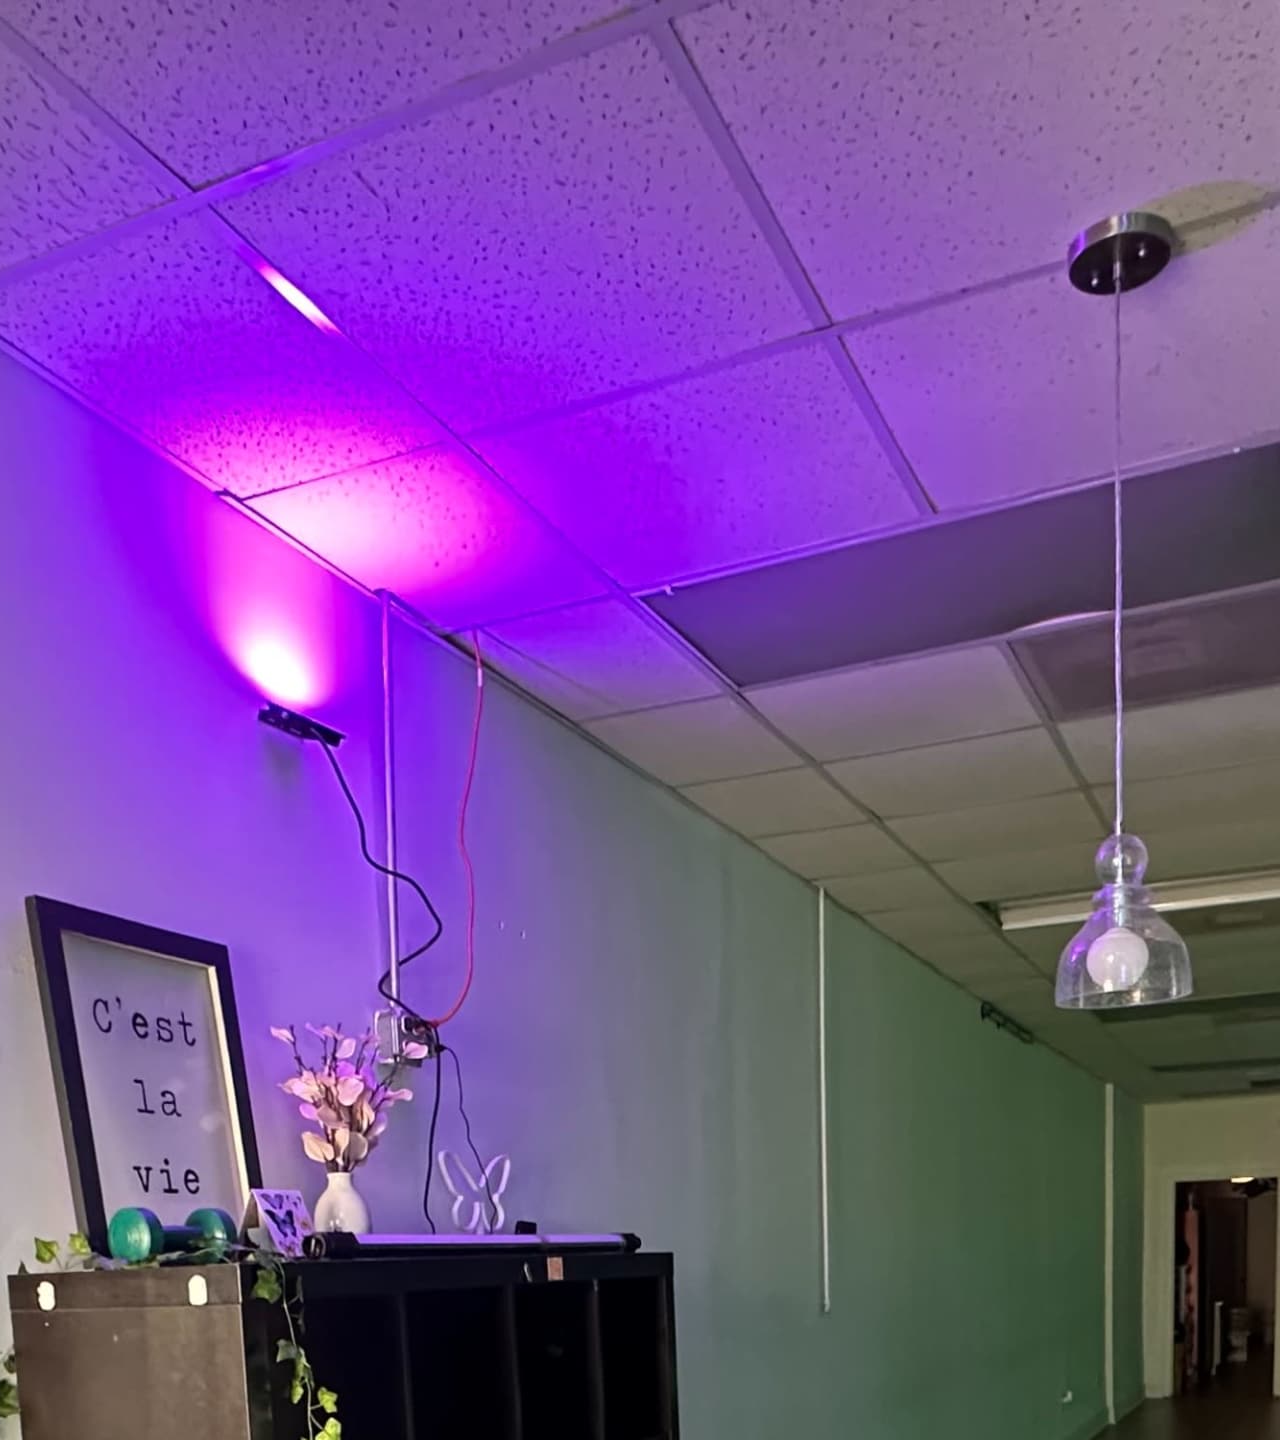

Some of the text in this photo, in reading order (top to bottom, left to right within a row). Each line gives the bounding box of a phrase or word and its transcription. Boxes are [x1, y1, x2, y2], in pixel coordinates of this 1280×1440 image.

[91, 996, 197, 1048] C'est
[132, 1078, 183, 1118] la
[132, 1157, 201, 1195] vie
